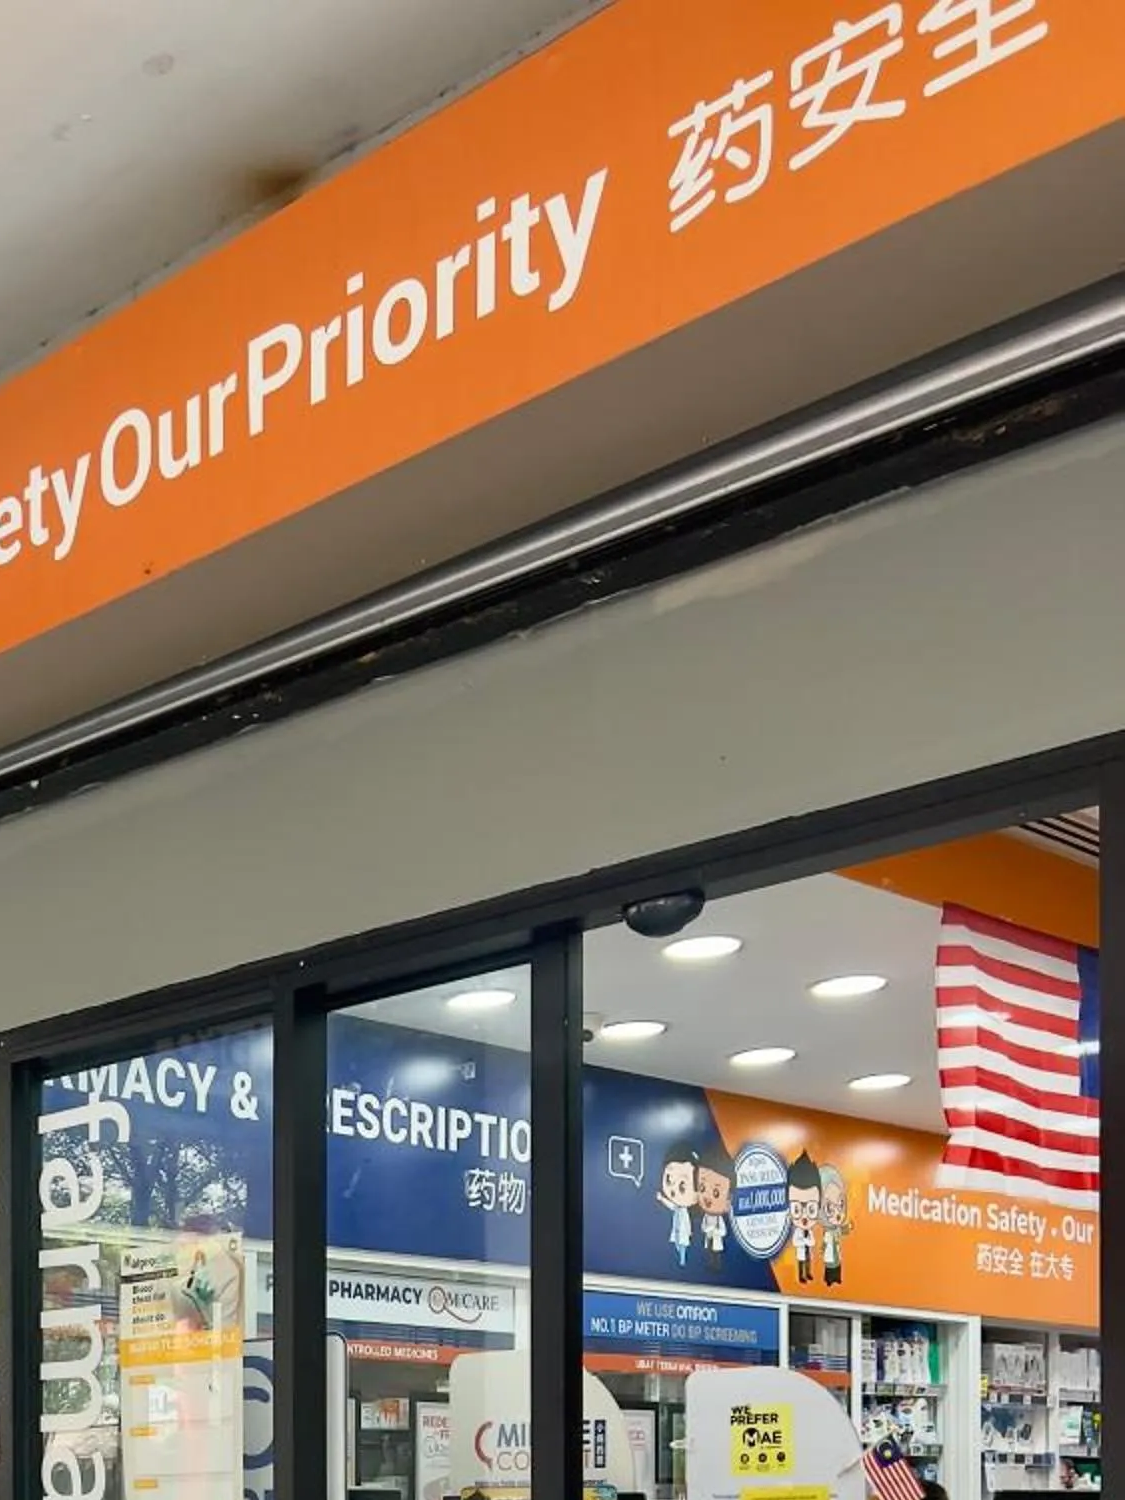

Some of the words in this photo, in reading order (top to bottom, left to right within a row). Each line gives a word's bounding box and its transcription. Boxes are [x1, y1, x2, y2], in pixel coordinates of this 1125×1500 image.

[668, 0, 1049, 233] 药安全
[101, 373, 236, 507] Our
[248, 166, 608, 438] Priority
[44, 1057, 217, 1113] MACY
[230, 1071, 260, 1121] &
[328, 1087, 531, 1164] ESCRIPTIO
[868, 1184, 982, 1229] Medication
[987, 1204, 1047, 1243] Safety
[1062, 1216, 1095, 1244] Our
[329, 1279, 423, 1304] PHARMACY
[654, 1302, 675, 1318] USE
[634, 1321, 670, 1338] METER
[347, 1343, 391, 1357] NTROLLED
[730, 1412, 779, 1426] PREFER
[731, 1405, 751, 1415] WE
[742, 1427, 783, 1447] MAE
